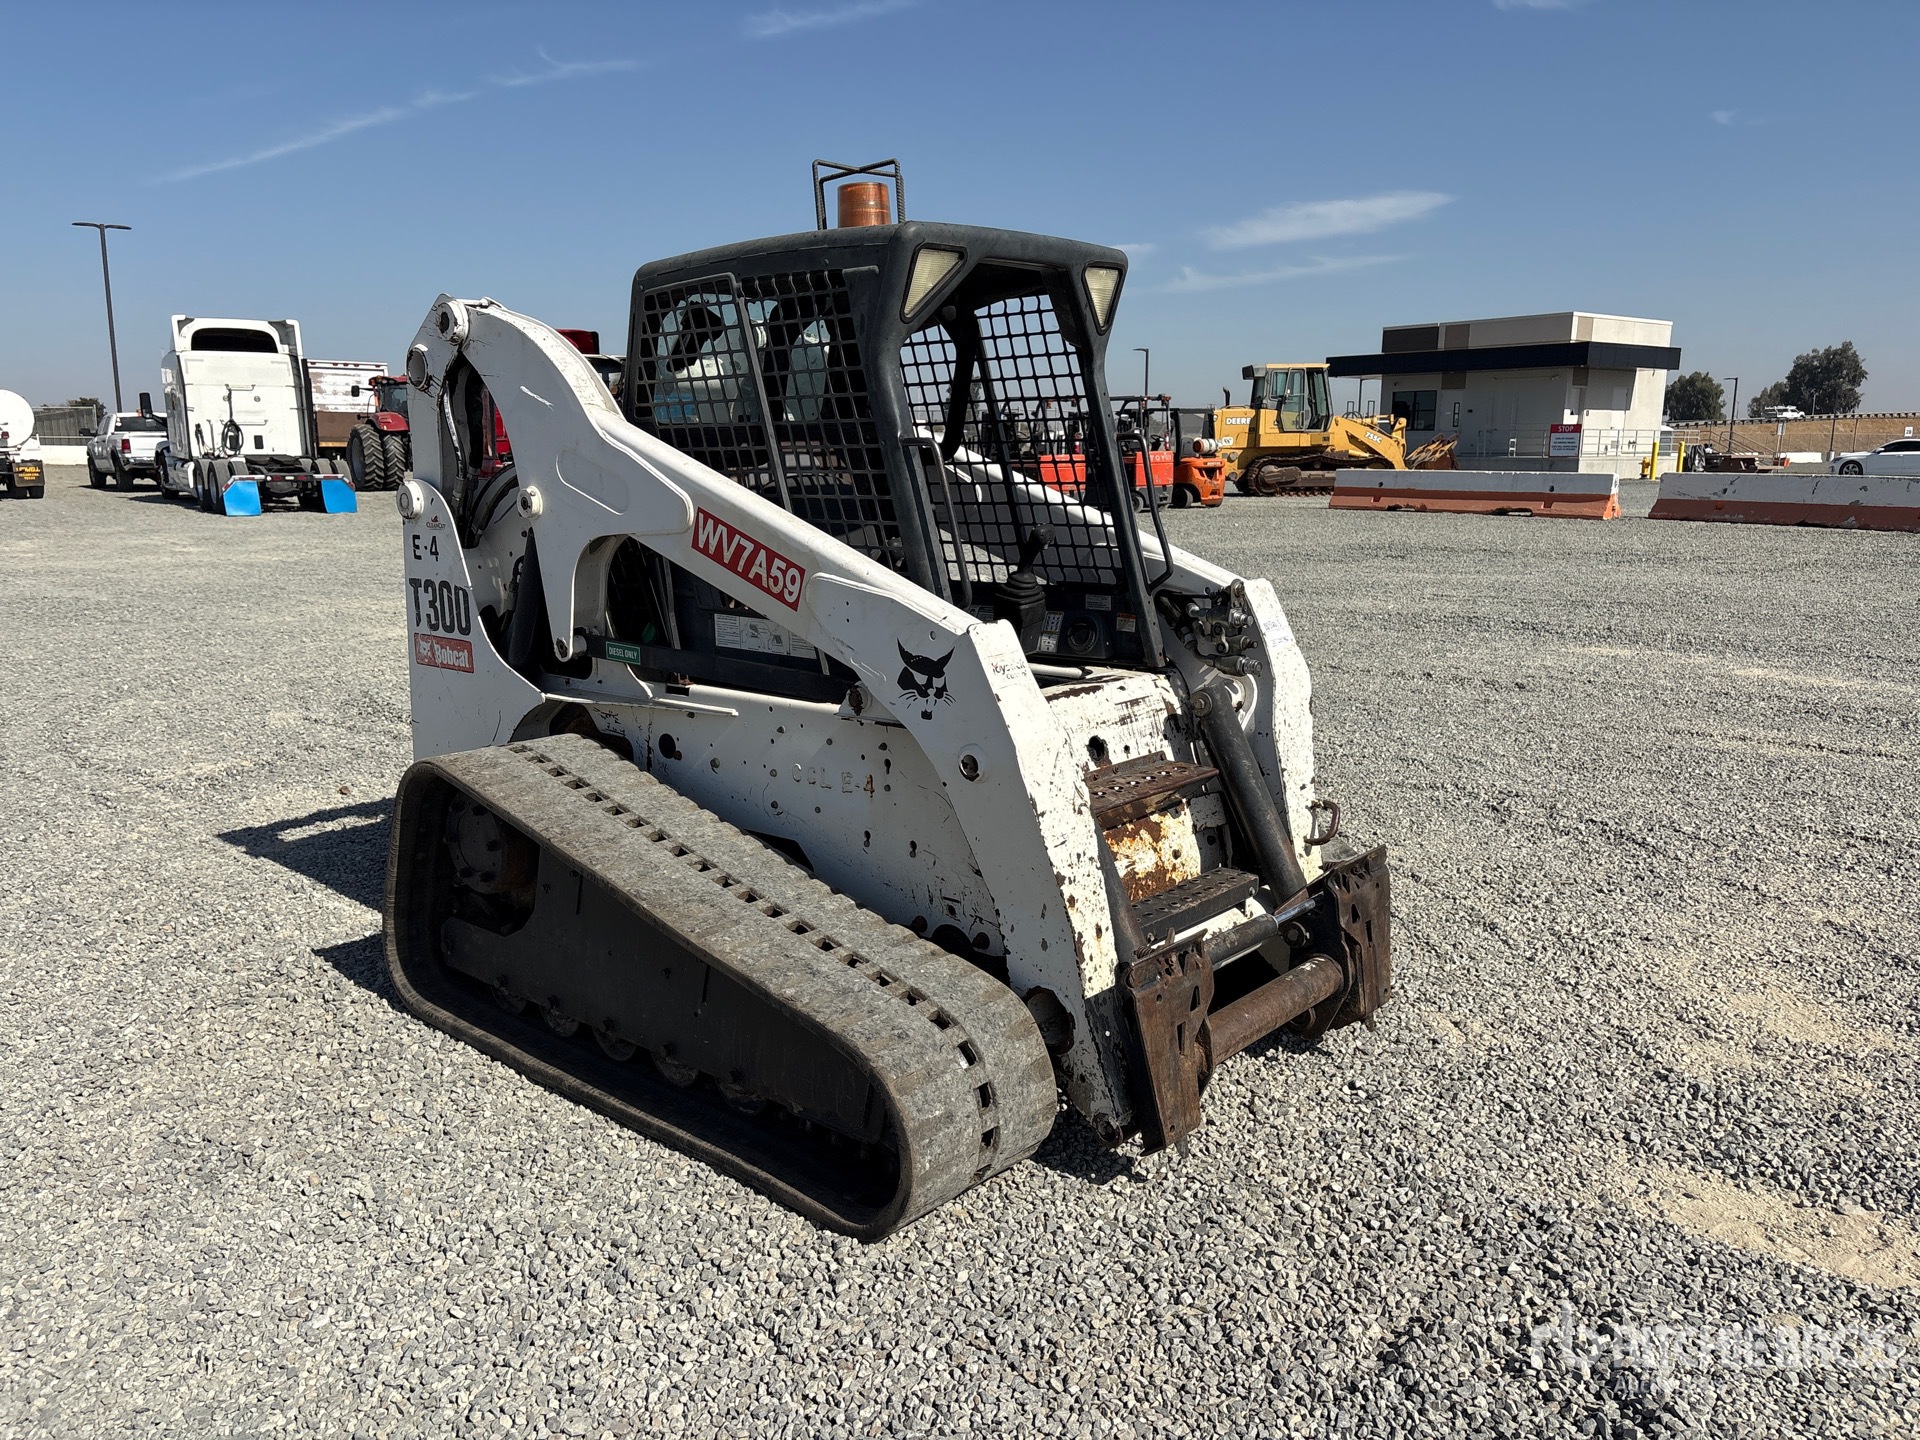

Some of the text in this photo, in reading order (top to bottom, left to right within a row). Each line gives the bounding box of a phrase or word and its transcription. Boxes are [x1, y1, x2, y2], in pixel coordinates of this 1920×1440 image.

[1365, 431, 1382, 443] 755C
[698, 512, 801, 603] WV7A59
[408, 577, 471, 636] T300
[433, 643, 470, 668] Bobcat
[608, 646, 638, 660] DIESEL ONLY
